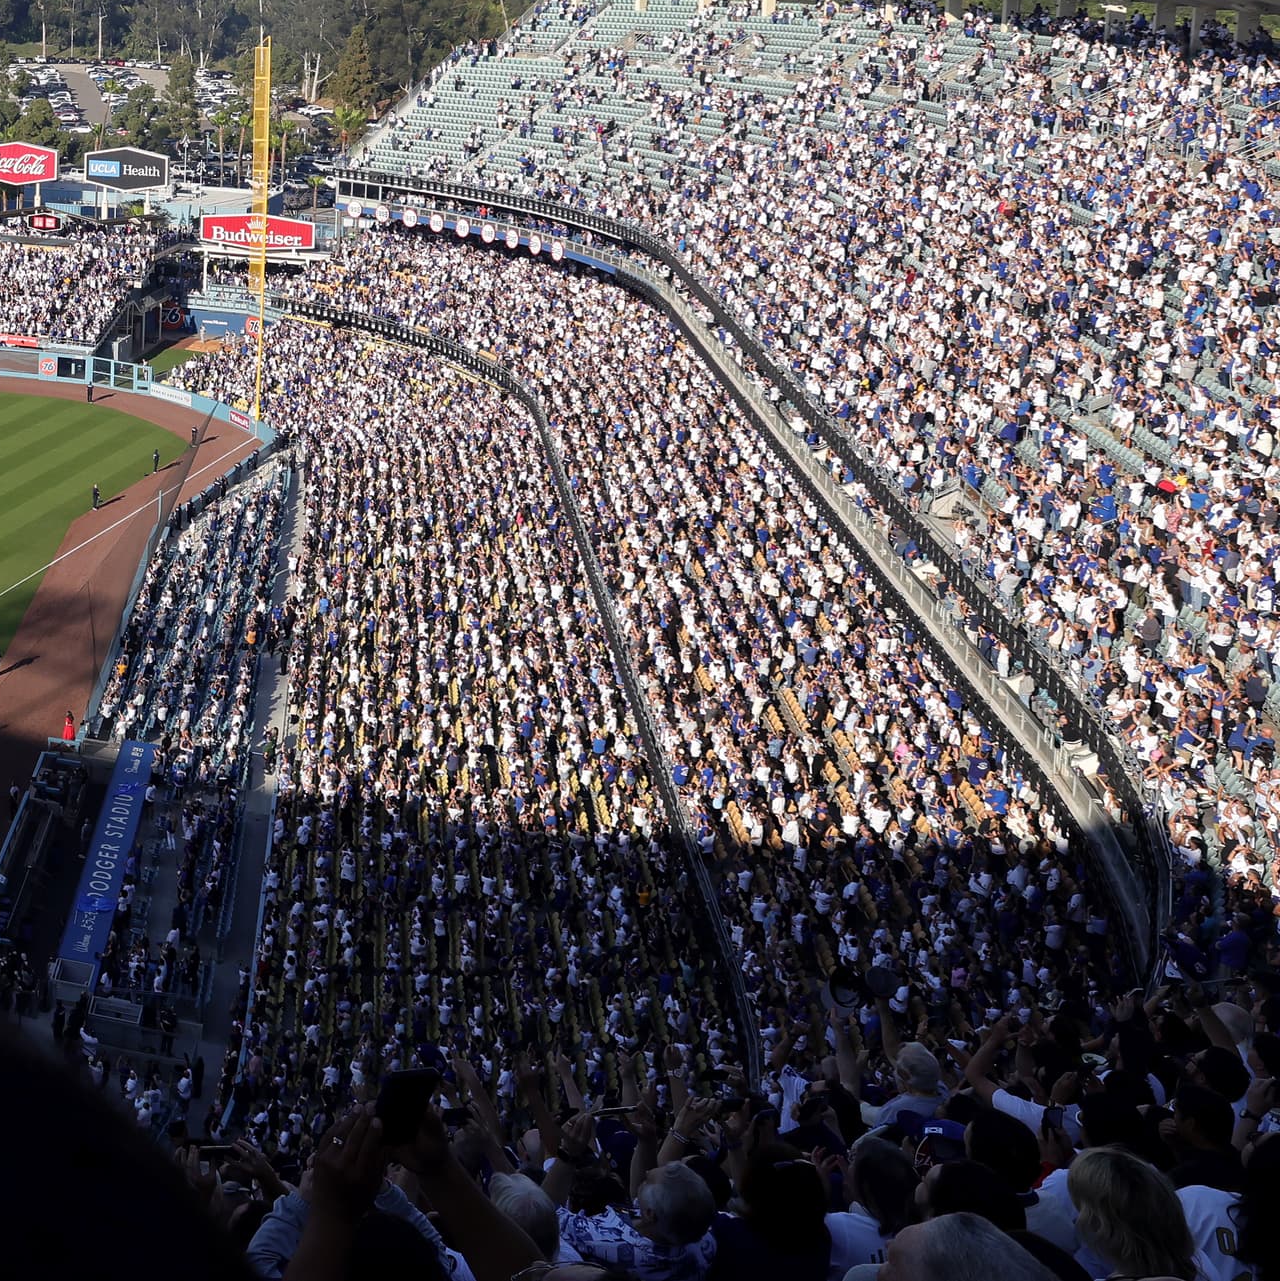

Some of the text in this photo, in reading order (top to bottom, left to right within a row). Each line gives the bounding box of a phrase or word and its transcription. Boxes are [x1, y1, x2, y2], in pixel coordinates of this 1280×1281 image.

[90, 162, 161, 177] UCLA Health
[211, 226, 302, 246] Budweiser
[250, 320, 261, 331] 76
[42, 362, 55, 371] 76
[105, 790, 134, 839] STADIU
